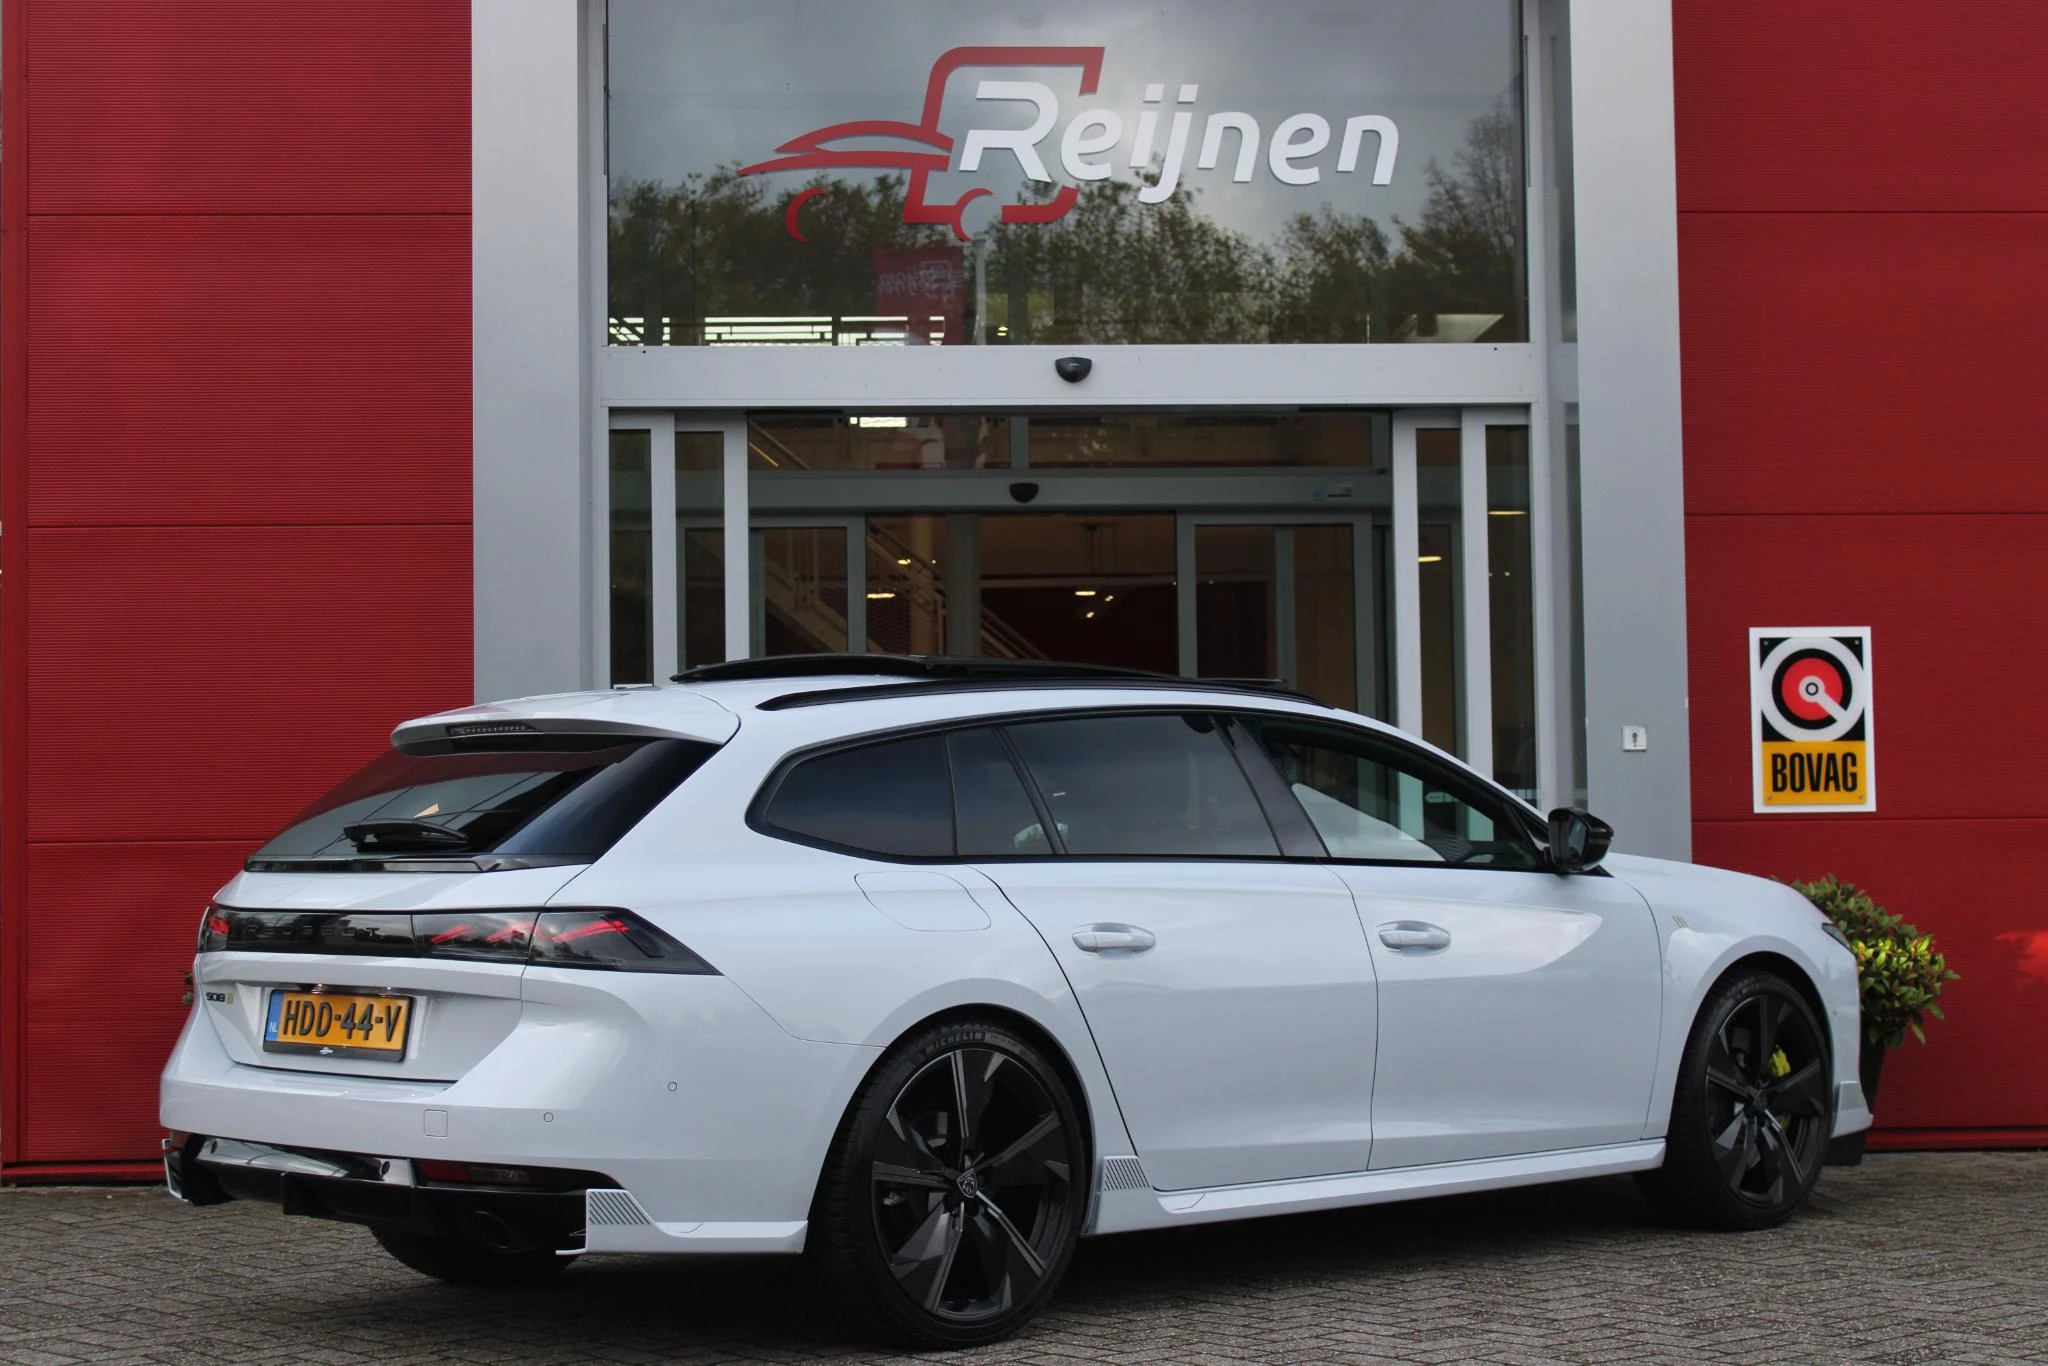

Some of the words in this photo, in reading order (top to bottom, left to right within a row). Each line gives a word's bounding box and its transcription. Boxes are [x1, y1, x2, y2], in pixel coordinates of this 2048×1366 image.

[958, 80, 1400, 204] Reijnen
[1771, 752, 1858, 792] BOVAG
[269, 1021, 278, 1033] NL
[283, 1000, 402, 1041] HDD-44-V
[926, 1031, 984, 1054] MICHELIN
